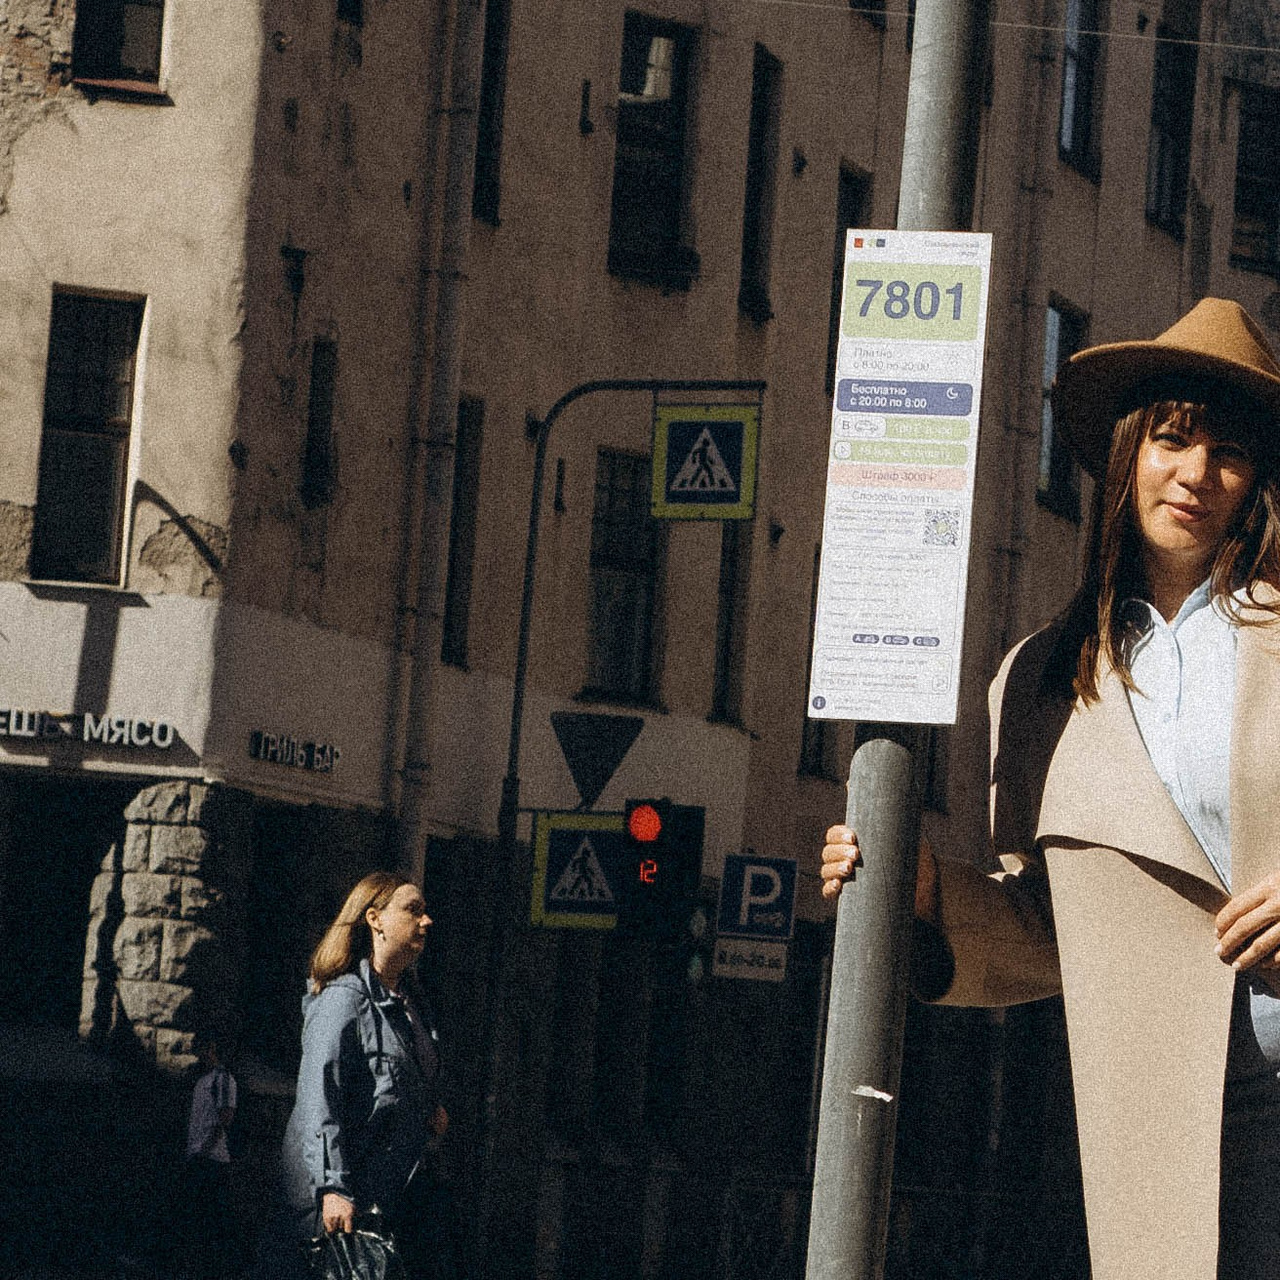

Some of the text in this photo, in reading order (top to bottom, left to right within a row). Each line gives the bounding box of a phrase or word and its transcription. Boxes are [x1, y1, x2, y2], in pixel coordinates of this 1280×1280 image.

[856, 279, 964, 321] 7801
[851, 383, 908, 396] Бесплатно
[889, 398, 903, 407] по
[862, 471, 899, 482] Штраф
[83, 712, 175, 748] МЯСО
[258, 731, 342, 770] ГРИЛЬ БАР
[639, 859, 658, 883] 12
[738, 864, 782, 927] P
